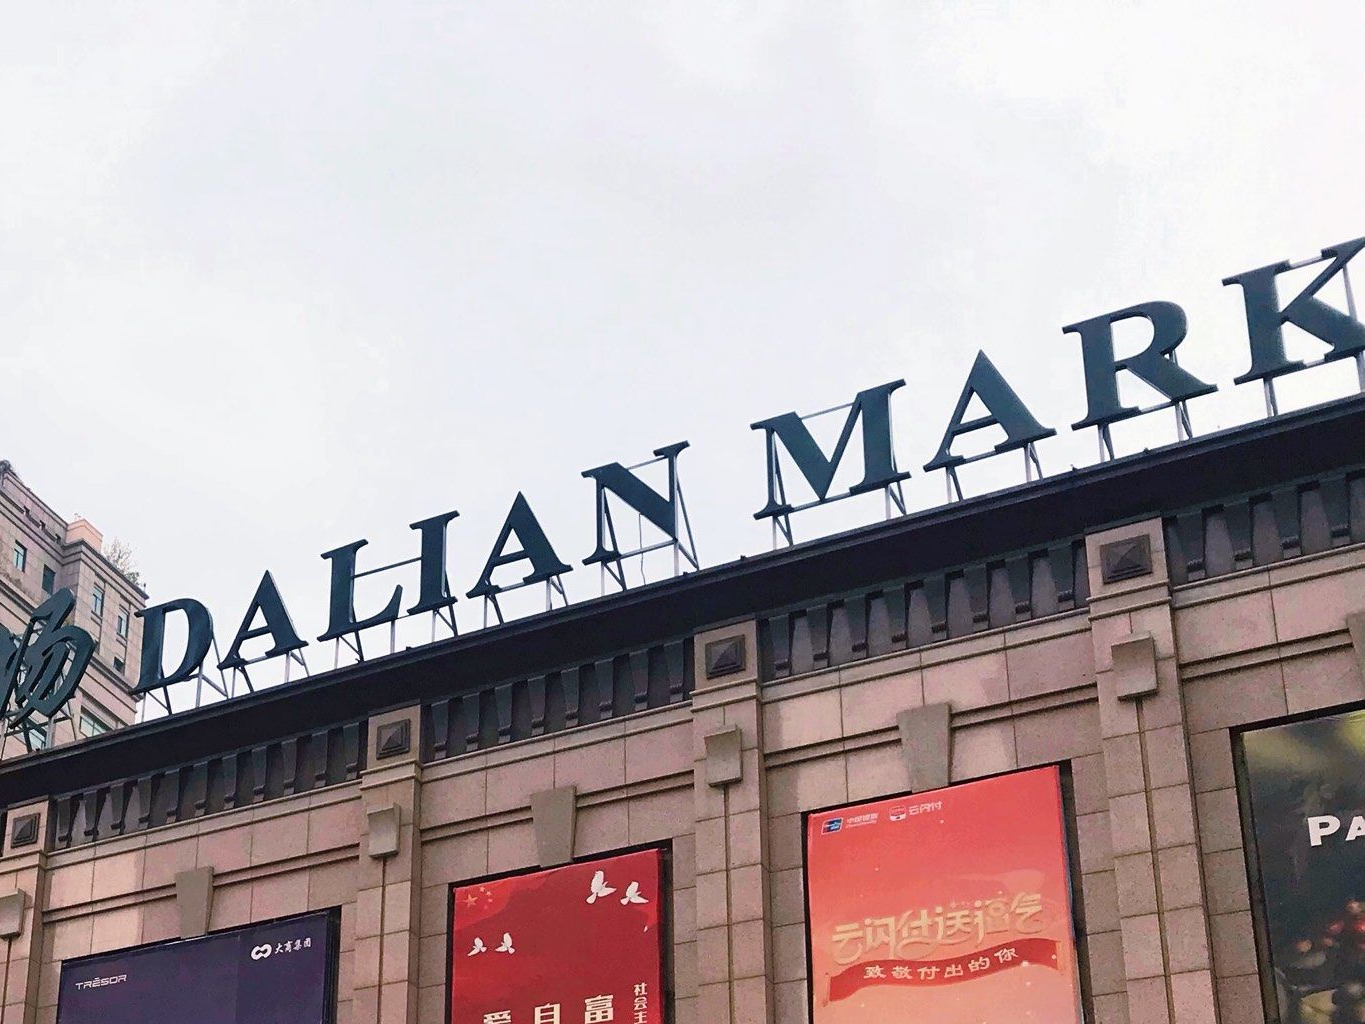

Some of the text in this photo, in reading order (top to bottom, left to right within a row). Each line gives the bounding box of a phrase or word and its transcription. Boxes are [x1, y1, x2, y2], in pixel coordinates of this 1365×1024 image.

[133, 440, 691, 695] DALIAN
[750, 236, 1365, 521] MARK
[908, 801, 943, 817] 云闪付
[274, 937, 312, 954] 大商集团
[863, 947, 1019, 980] 致敬付出的你
